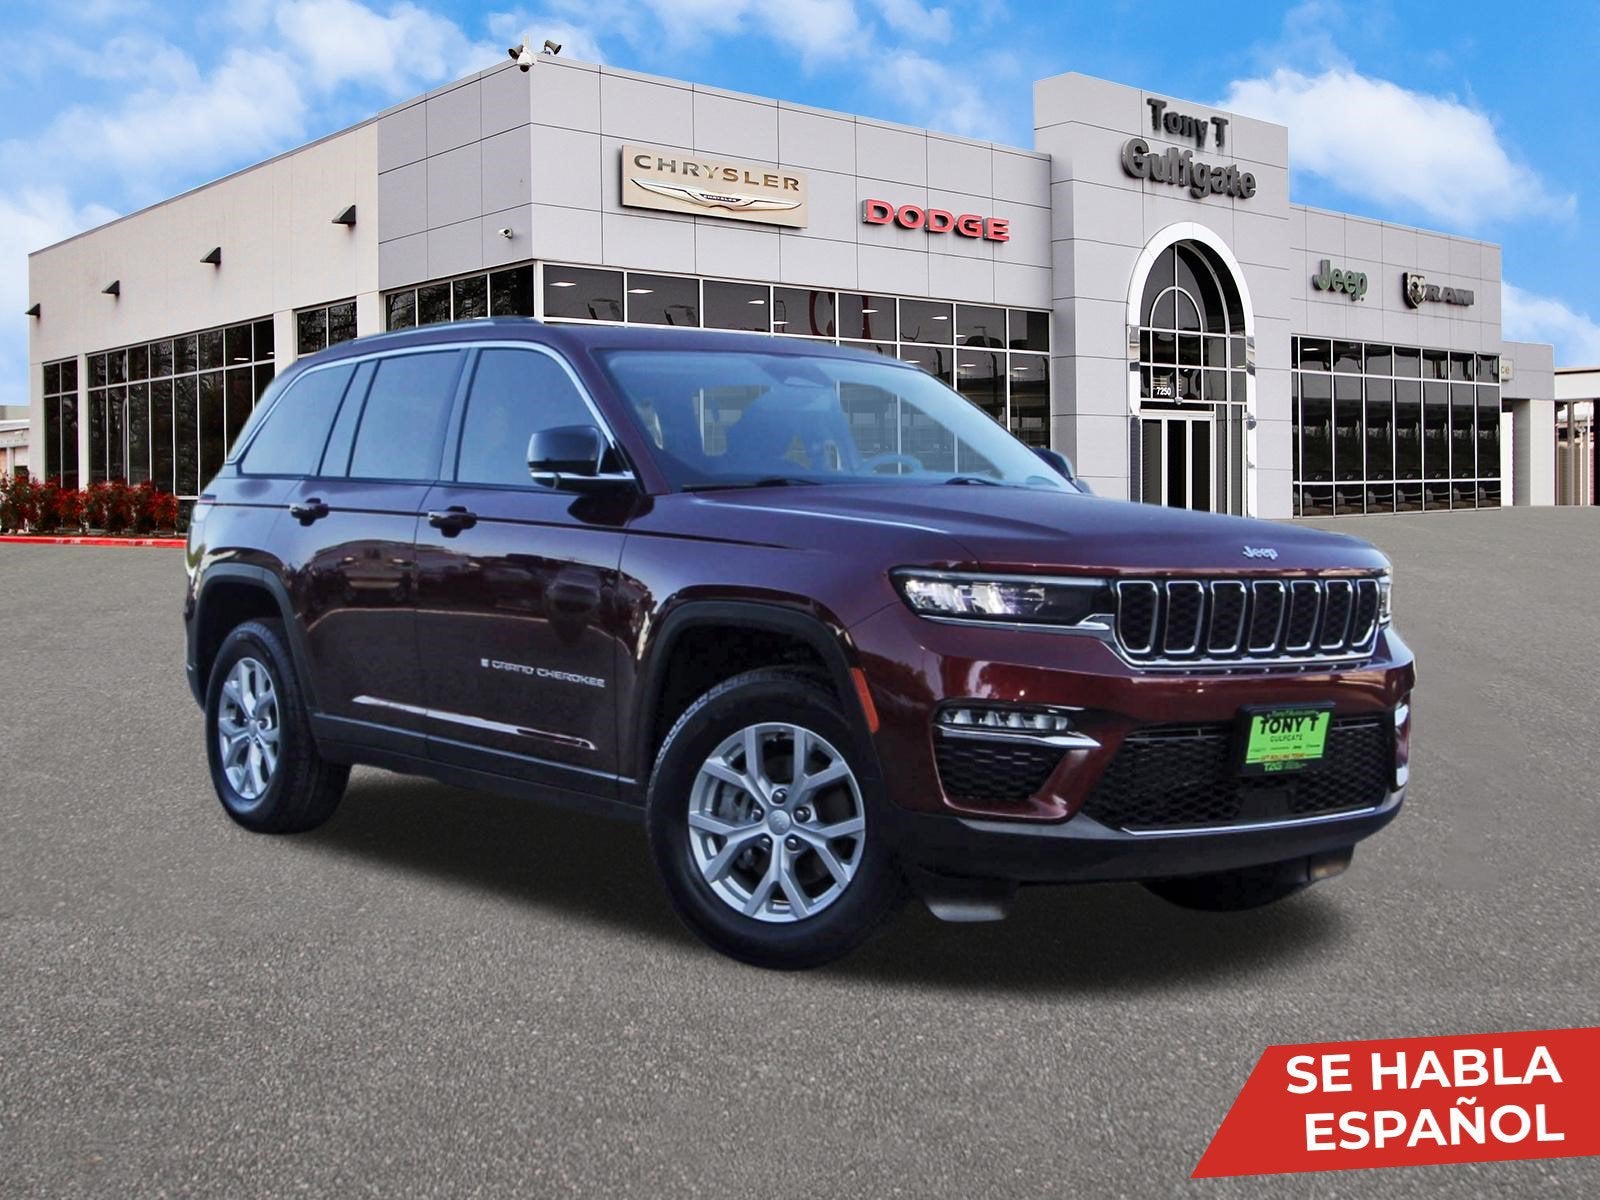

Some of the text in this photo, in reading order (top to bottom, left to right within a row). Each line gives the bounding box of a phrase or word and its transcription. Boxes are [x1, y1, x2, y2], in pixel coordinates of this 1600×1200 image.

[1146, 98, 1229, 147] Tony T
[634, 154, 799, 191] CHRYSLER
[1121, 138, 1256, 199] Gulfgate
[863, 199, 1010, 243] DODGE
[1312, 259, 1368, 302] Jeep
[1425, 283, 1474, 306] RAM
[1242, 545, 1279, 560] Jeep
[491, 659, 606, 688] GRAND CHEROKEE
[1259, 714, 1320, 735] TONY T
